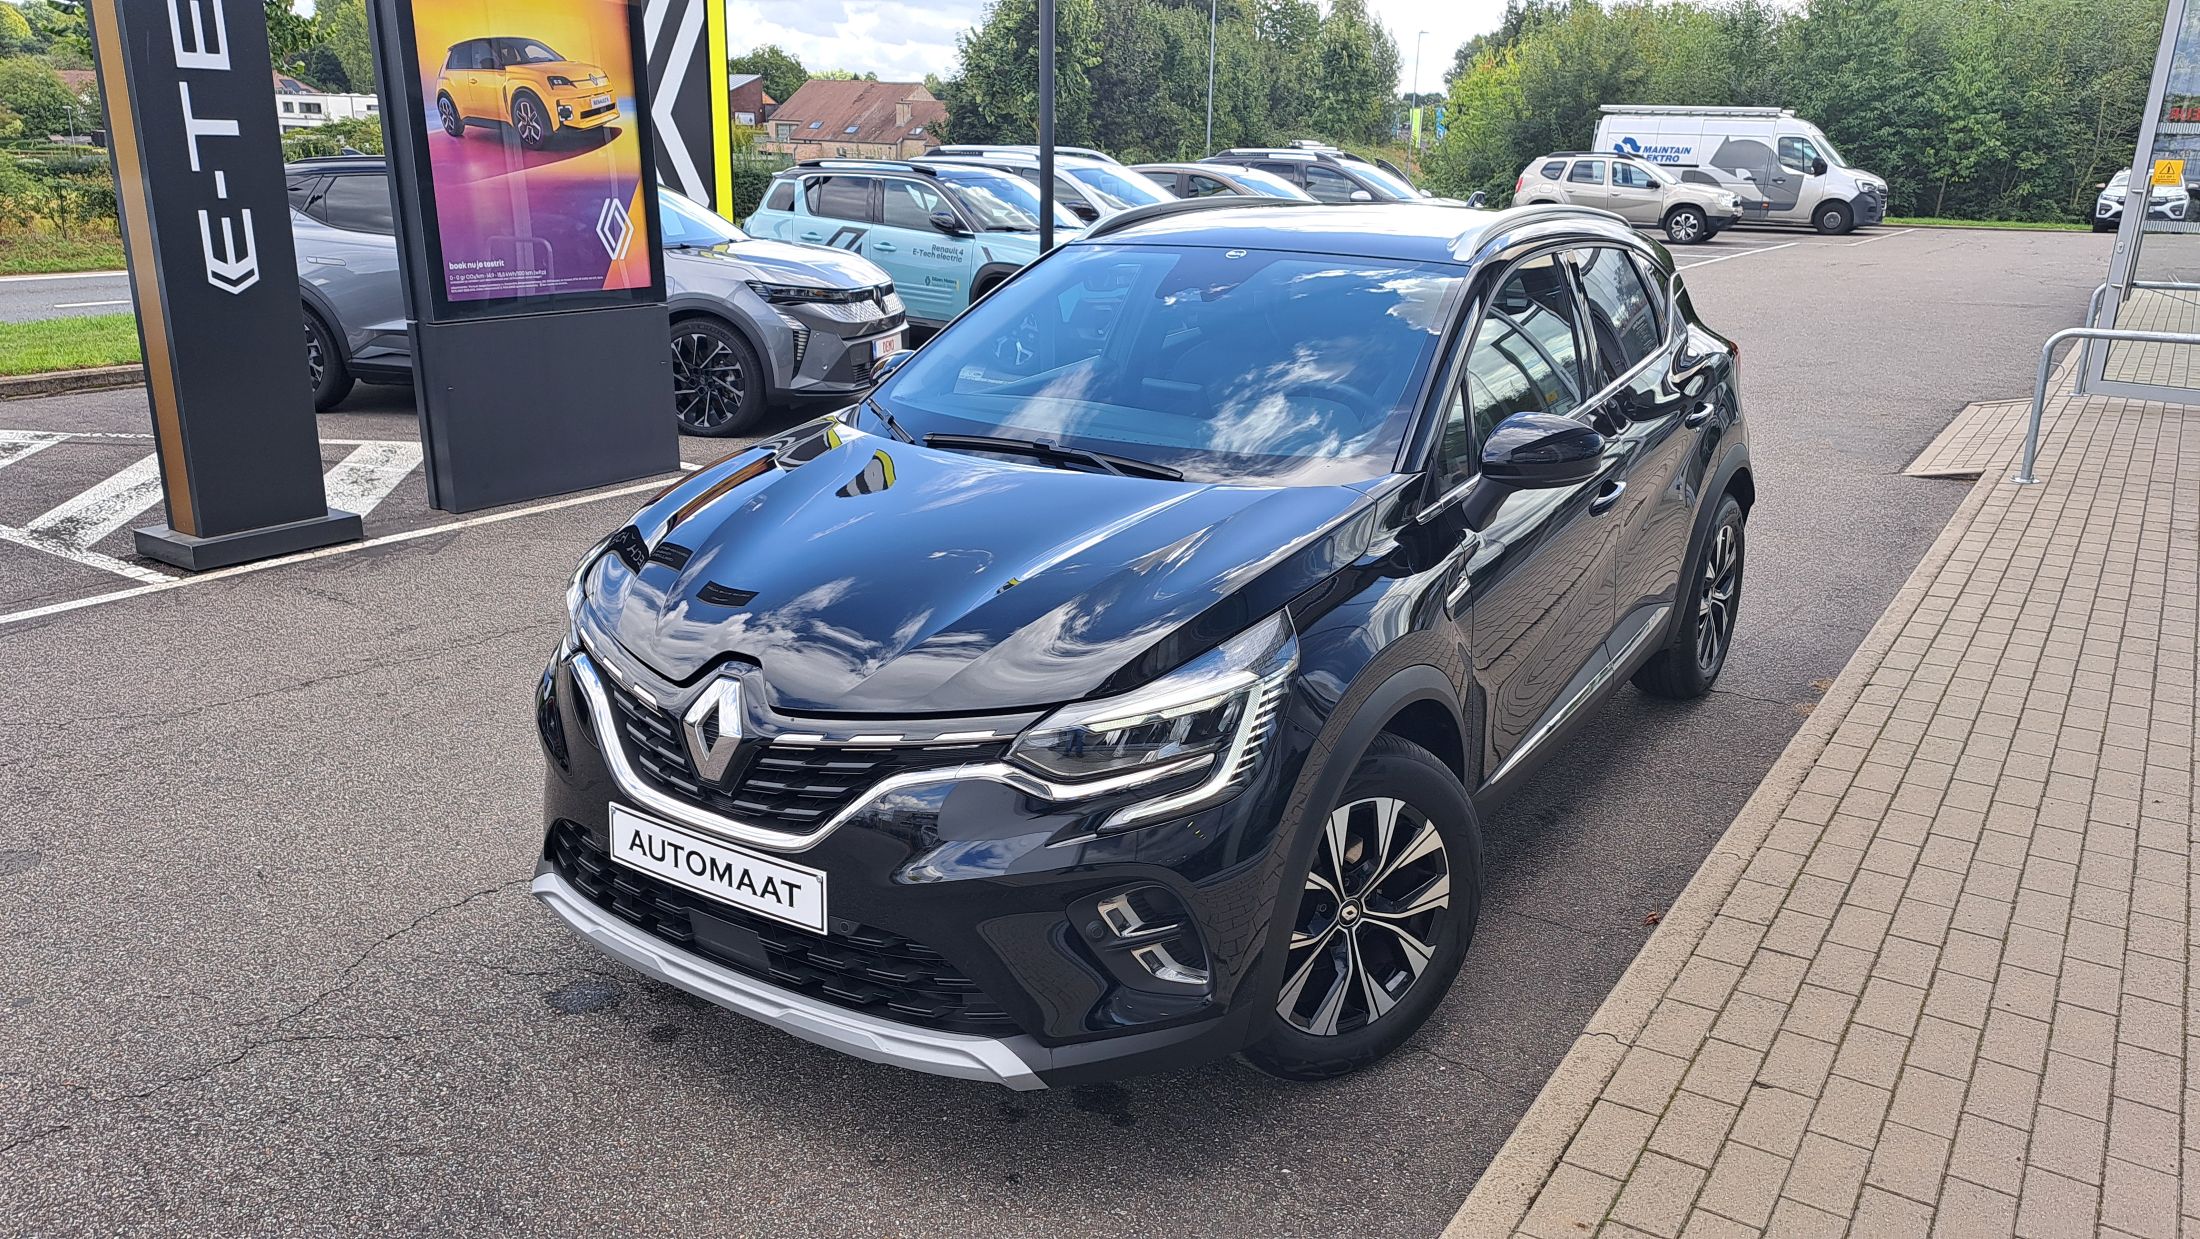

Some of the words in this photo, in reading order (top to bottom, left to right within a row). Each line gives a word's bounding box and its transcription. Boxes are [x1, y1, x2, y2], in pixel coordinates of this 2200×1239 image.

[1643, 146, 1691, 154] MAINTAIN
[1642, 154, 1680, 162] EKTRO
[912, 248, 936, 258] E-Tech
[936, 253, 962, 262] electric
[932, 244, 958, 255] Renault
[958, 248, 964, 256] 4
[449, 261, 467, 270] book
[467, 261, 476, 270] nu
[483, 260, 505, 268] testrit
[883, 338, 894, 353] DEMO
[629, 829, 801, 907] AUTOMAAT
